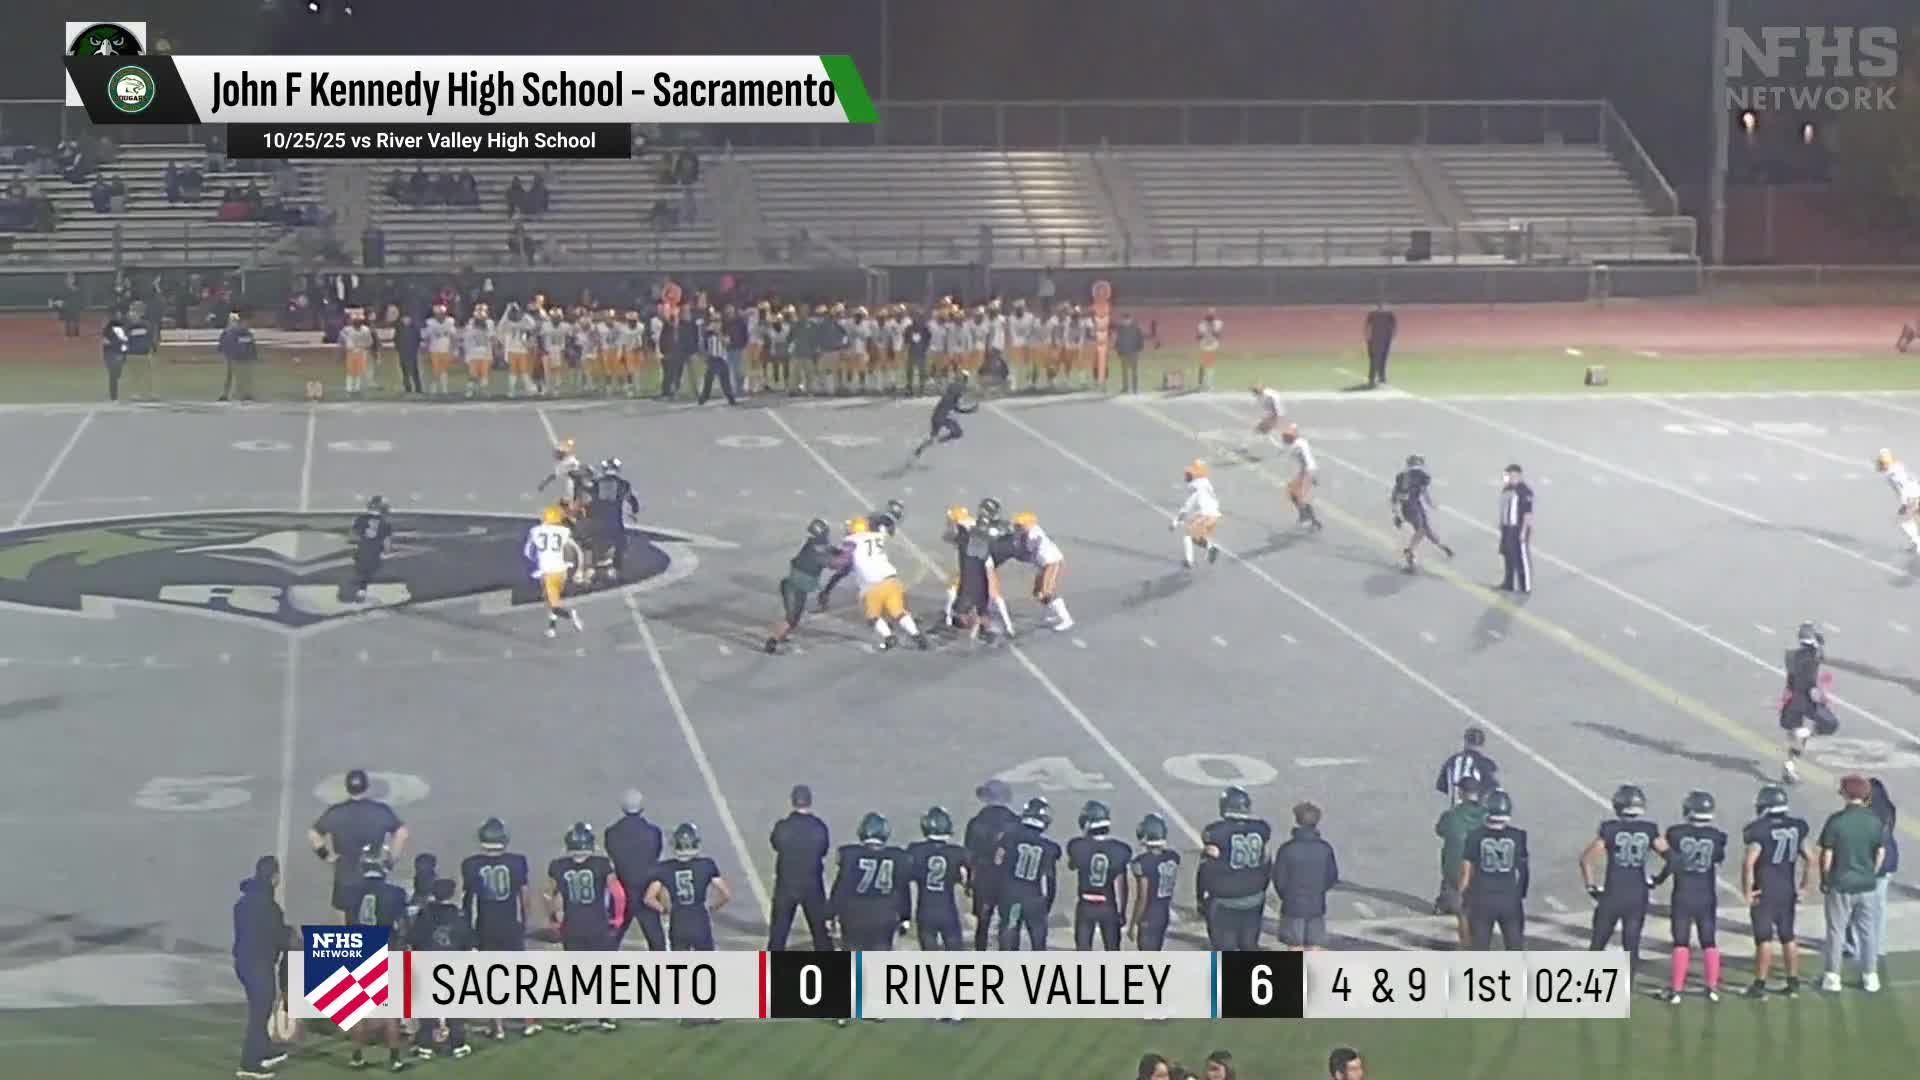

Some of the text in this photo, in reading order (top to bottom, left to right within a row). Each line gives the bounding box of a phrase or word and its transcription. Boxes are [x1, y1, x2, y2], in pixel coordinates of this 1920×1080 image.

[539, 533, 564, 551] 33
[1015, 843, 1043, 881] 11
[1772, 827, 1799, 864] 71
[480, 864, 510, 901] 10
[564, 869, 595, 904] 18
[675, 869, 695, 905] 5
[856, 858, 893, 894] 74
[927, 855, 947, 892] 2
[1089, 853, 1109, 887] 9
